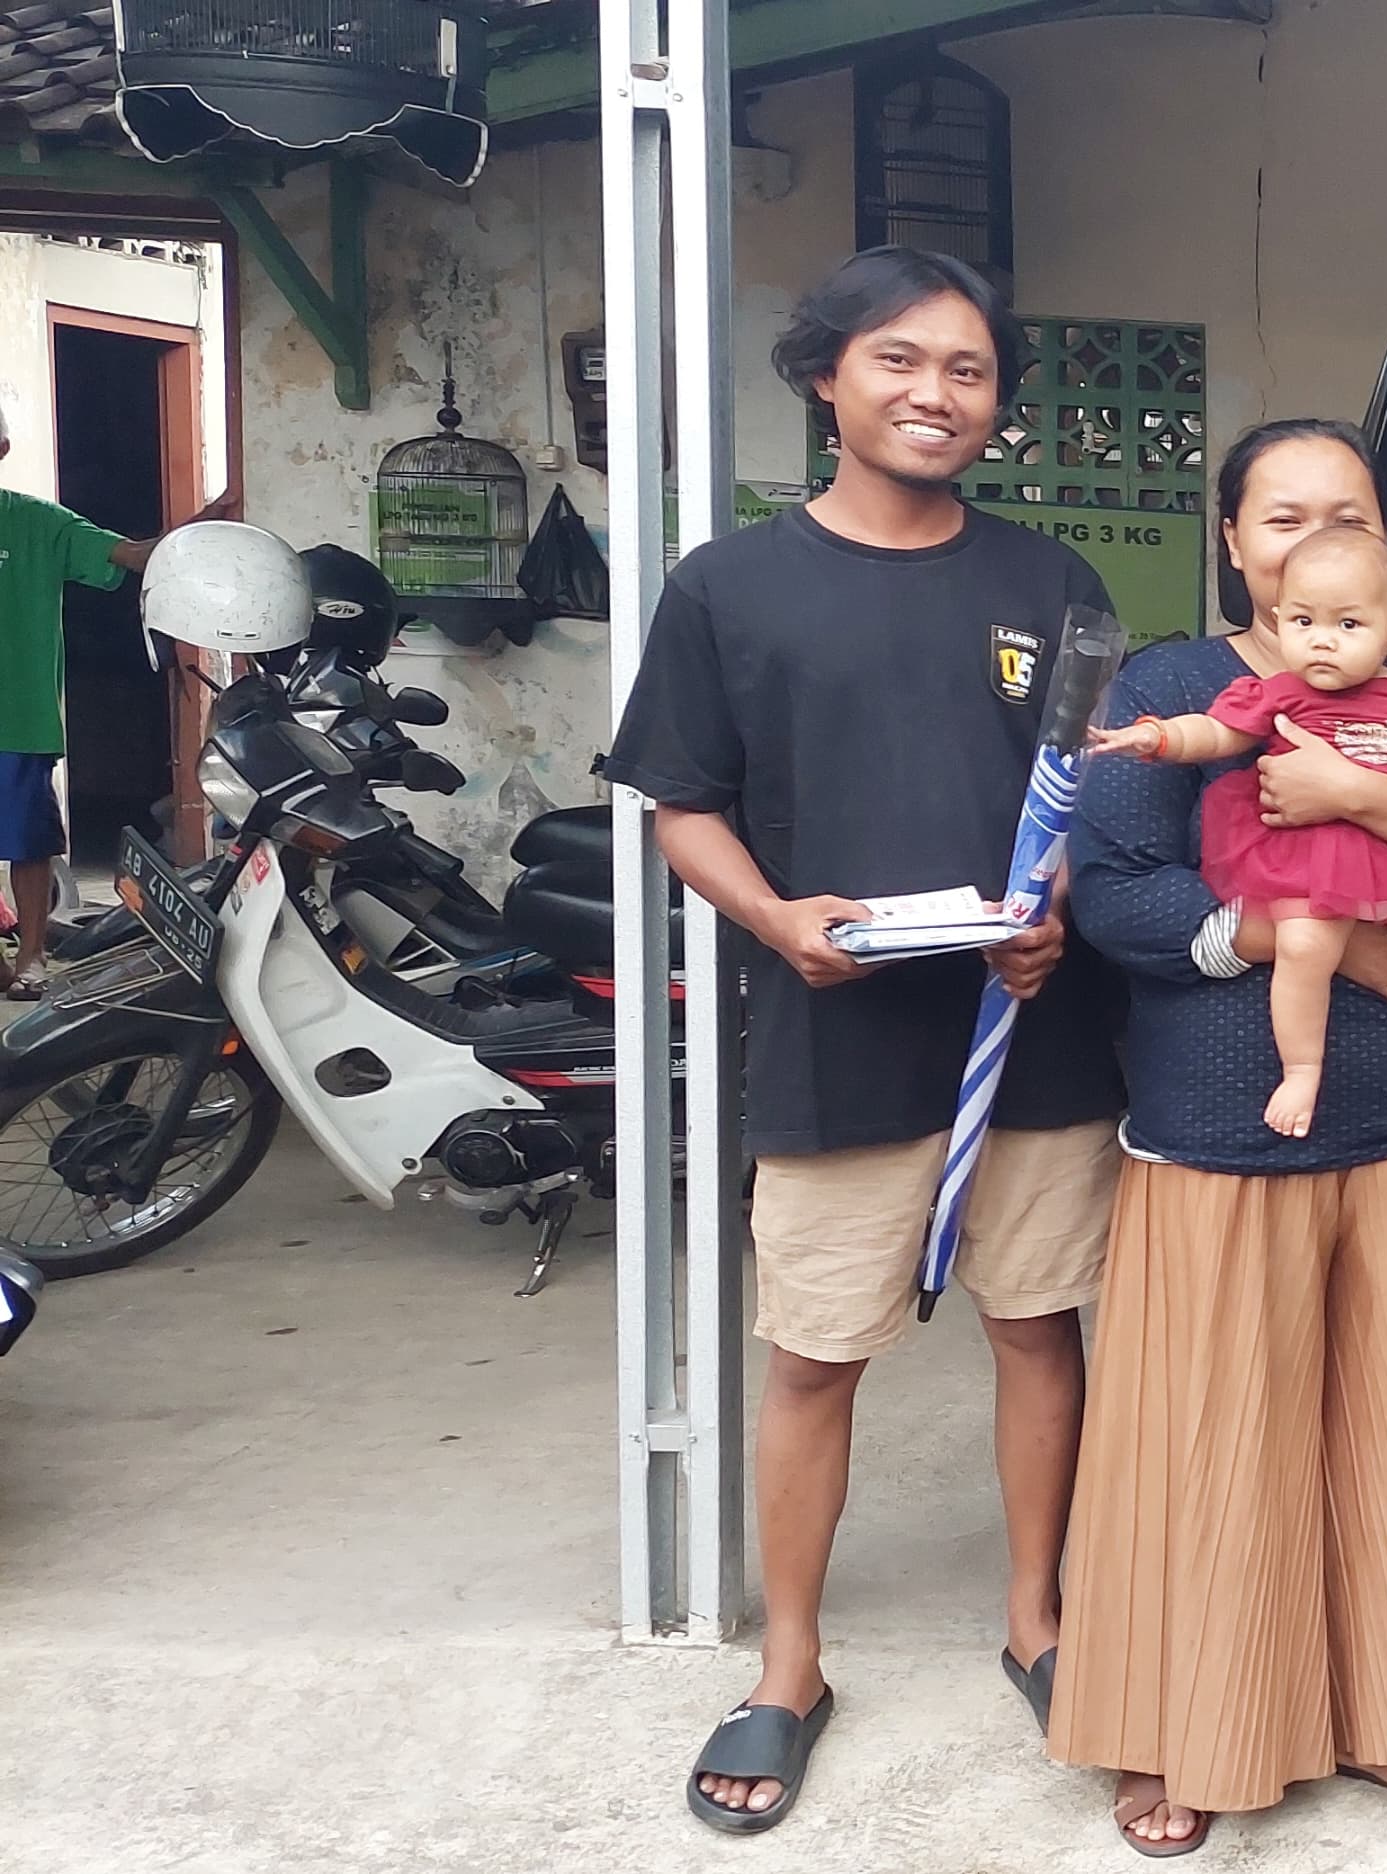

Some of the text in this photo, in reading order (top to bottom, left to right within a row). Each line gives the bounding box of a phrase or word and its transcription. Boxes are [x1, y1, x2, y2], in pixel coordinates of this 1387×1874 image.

[1100, 525, 1115, 544] 3
[1124, 526, 1163, 546] KG
[998, 648, 1036, 687] 05
[124, 846, 210, 949] AB 4104 AU
